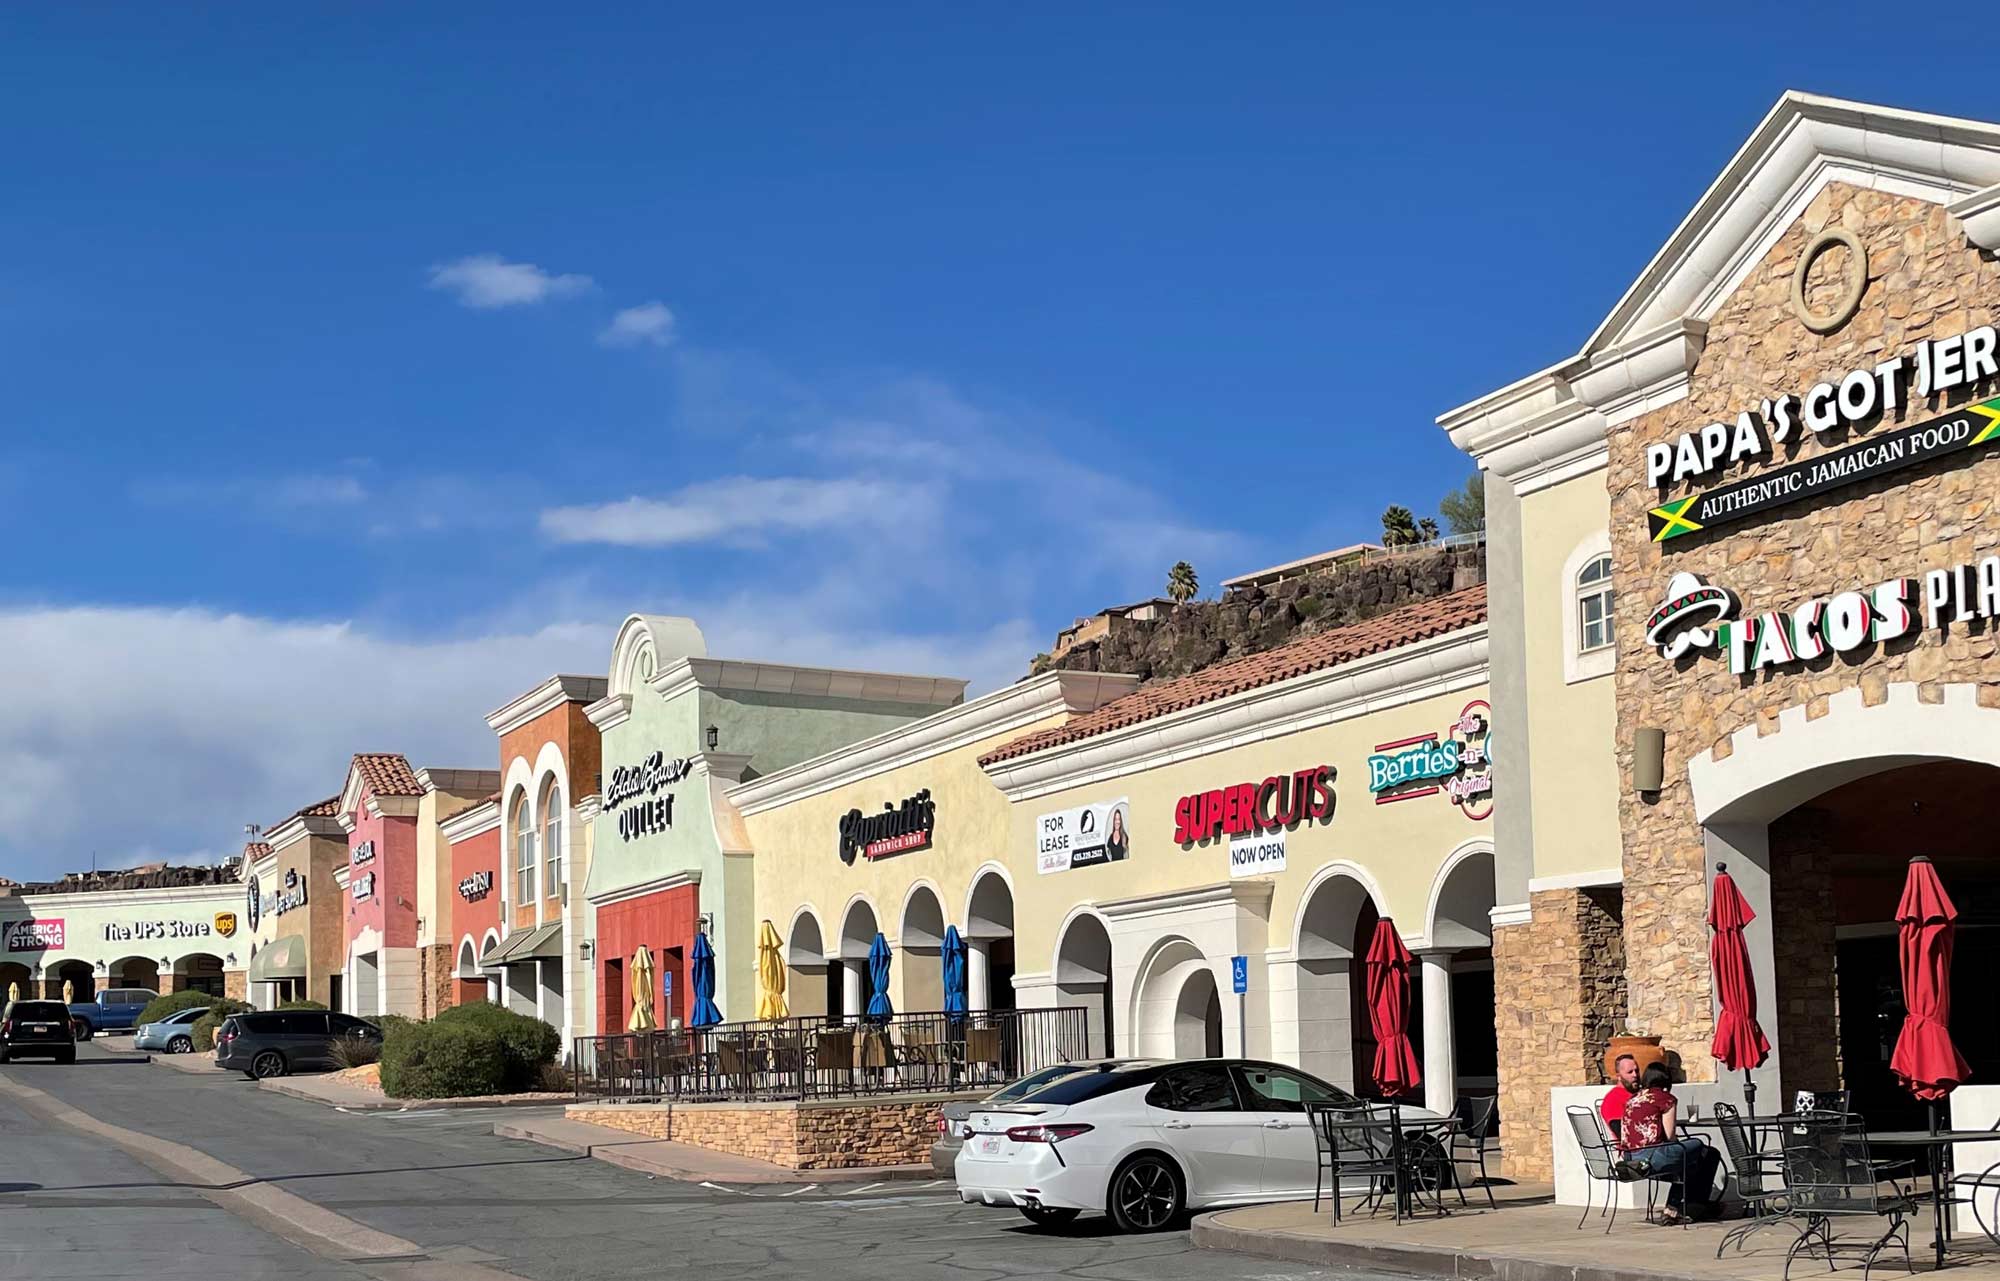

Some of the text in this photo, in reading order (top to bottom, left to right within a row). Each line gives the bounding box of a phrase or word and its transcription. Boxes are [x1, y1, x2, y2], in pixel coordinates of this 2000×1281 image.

[1647, 326, 1999, 489] PAPA'S GOT JER
[1700, 419, 1970, 520] AUTHENTIC JAMAICAN FOOD
[1717, 556, 2000, 674] TACOS PLA
[1369, 741, 1458, 791] Berries
[602, 751, 690, 814] Eddie Bauer
[1449, 769, 1491, 798] Original
[618, 794, 674, 840] OUTLET
[1174, 765, 1333, 844] SUPERCUTS
[1044, 816, 1064, 832] FOR
[870, 835, 921, 854] SANDWICH SHOP
[1040, 835, 1069, 853] LEASE
[1232, 842, 1285, 866] NOW OPEN
[12, 923, 62, 936] AMERICA
[102, 919, 210, 941] The UPS Store
[216, 919, 233, 934] ups
[11, 934, 63, 947] STRONG
